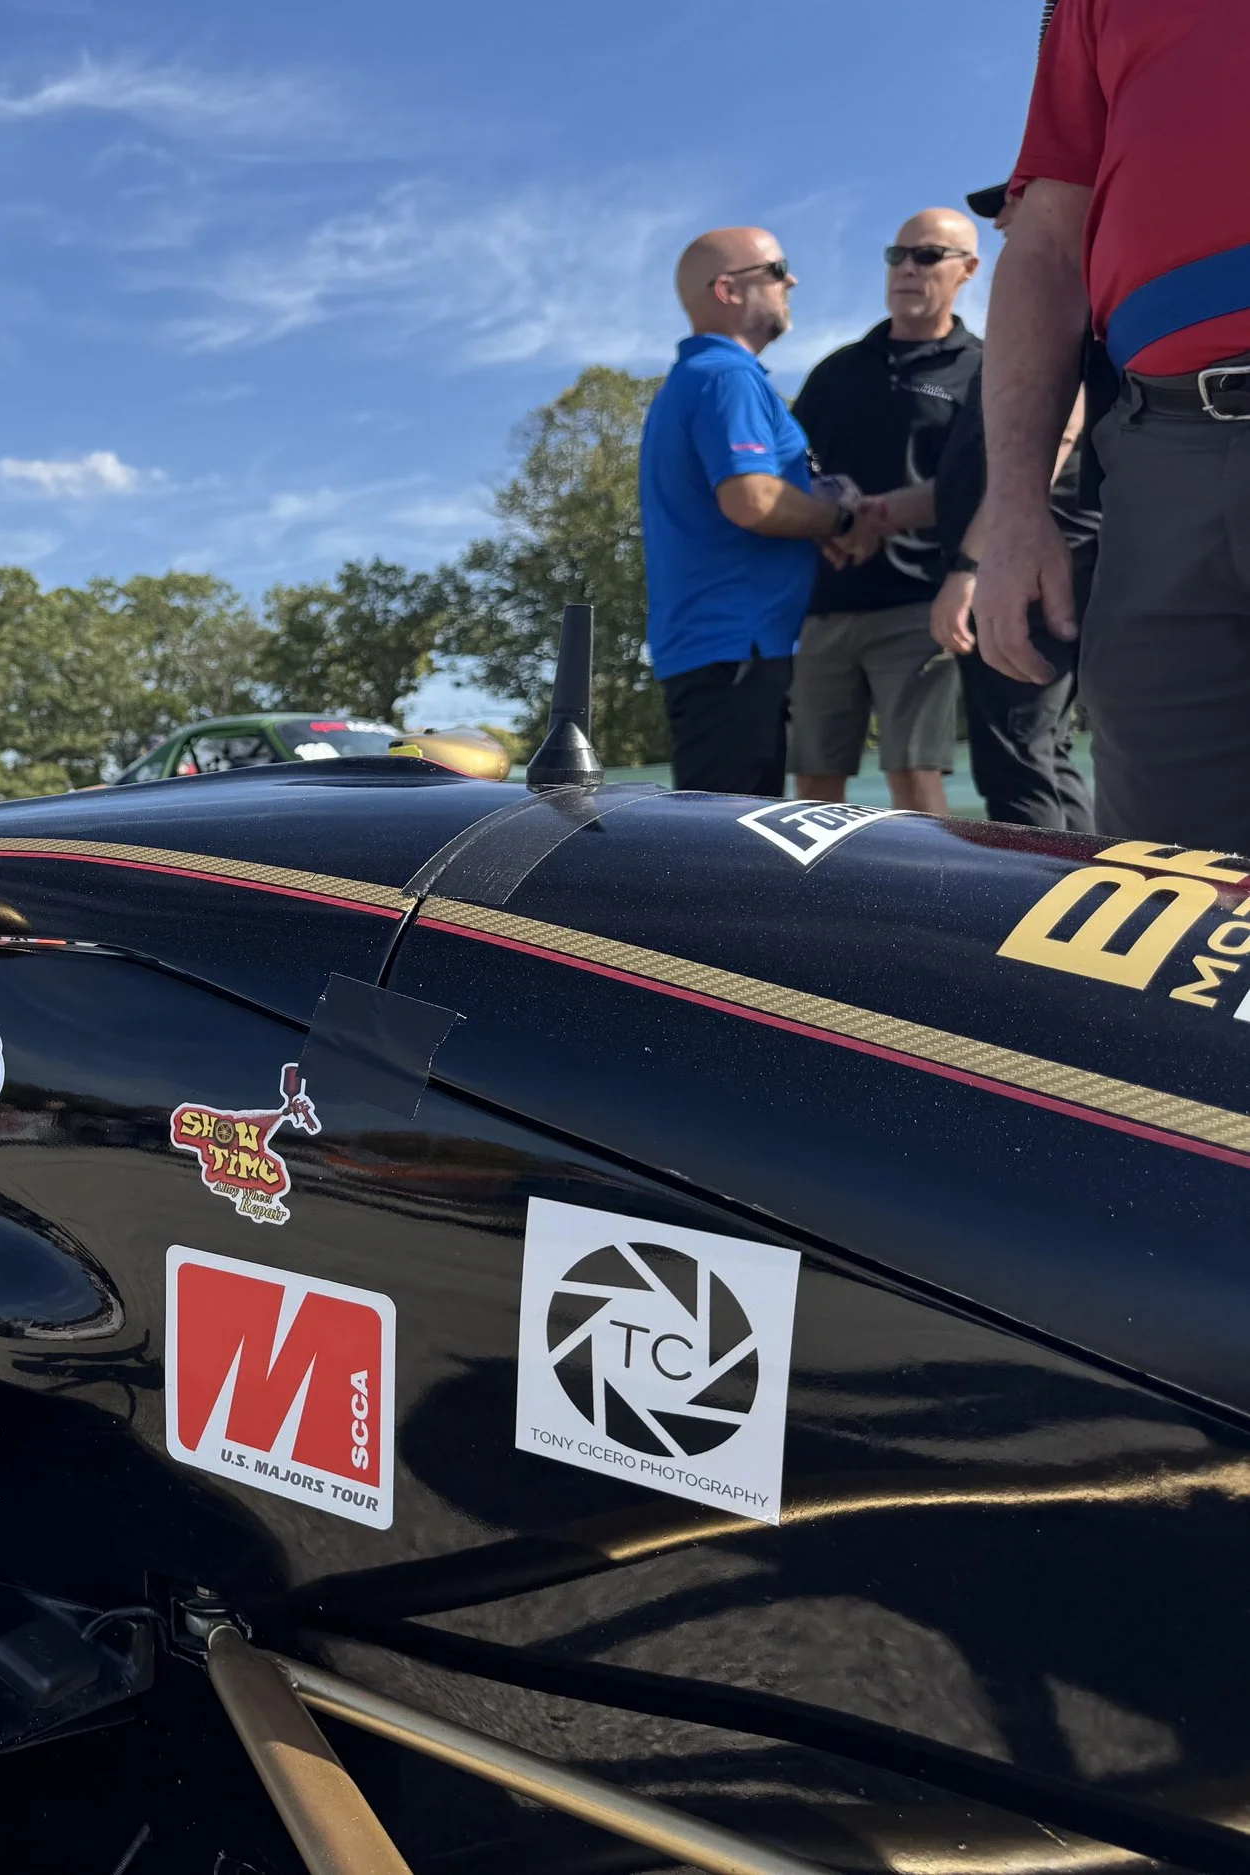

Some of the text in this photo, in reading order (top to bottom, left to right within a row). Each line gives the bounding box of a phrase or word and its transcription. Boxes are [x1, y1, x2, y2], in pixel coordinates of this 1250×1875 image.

[180, 1111, 261, 1152] SHOW
[213, 1180, 274, 1205] Alloy Wheel
[239, 1199, 287, 1222] Repair
[609, 1318, 694, 1381] TC
[350, 1369, 370, 1471] SCCA
[220, 1448, 379, 1512] U.S. MAJORS TOUR
[530, 1427, 769, 1508] TONY CICERO PHOTOGRAPHY
